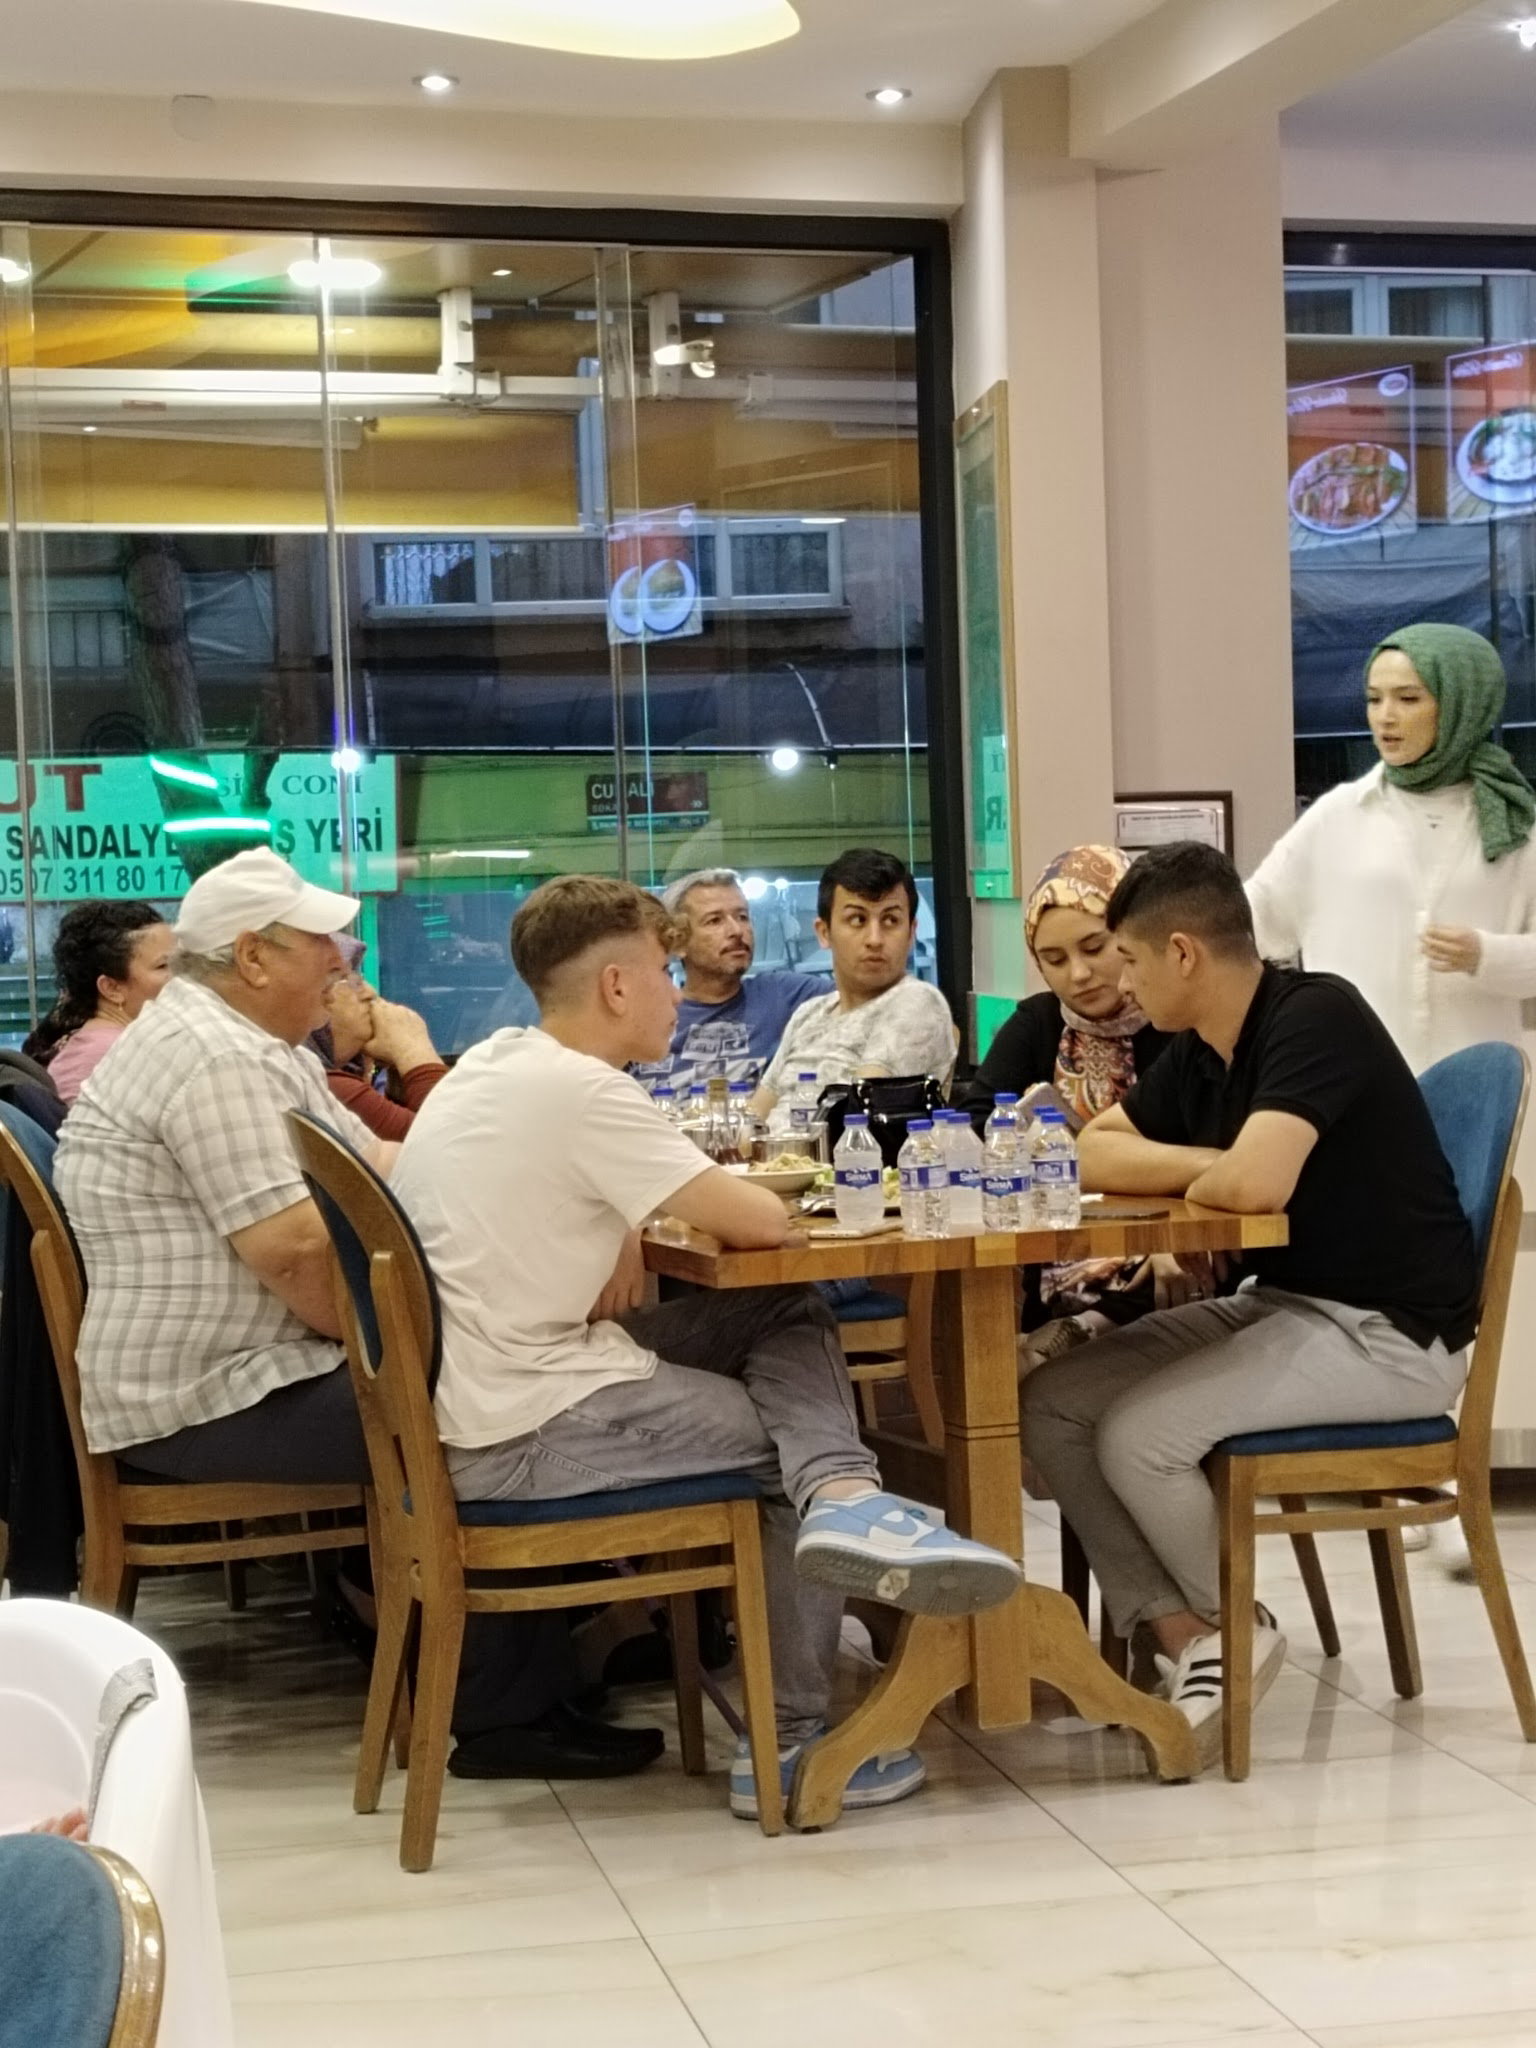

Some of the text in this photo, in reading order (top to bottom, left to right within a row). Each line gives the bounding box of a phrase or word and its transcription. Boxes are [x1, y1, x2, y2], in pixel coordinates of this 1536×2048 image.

[305, 807, 383, 853] YERİ
[63, 866, 104, 893] 311
[116, 865, 145, 893] 80
